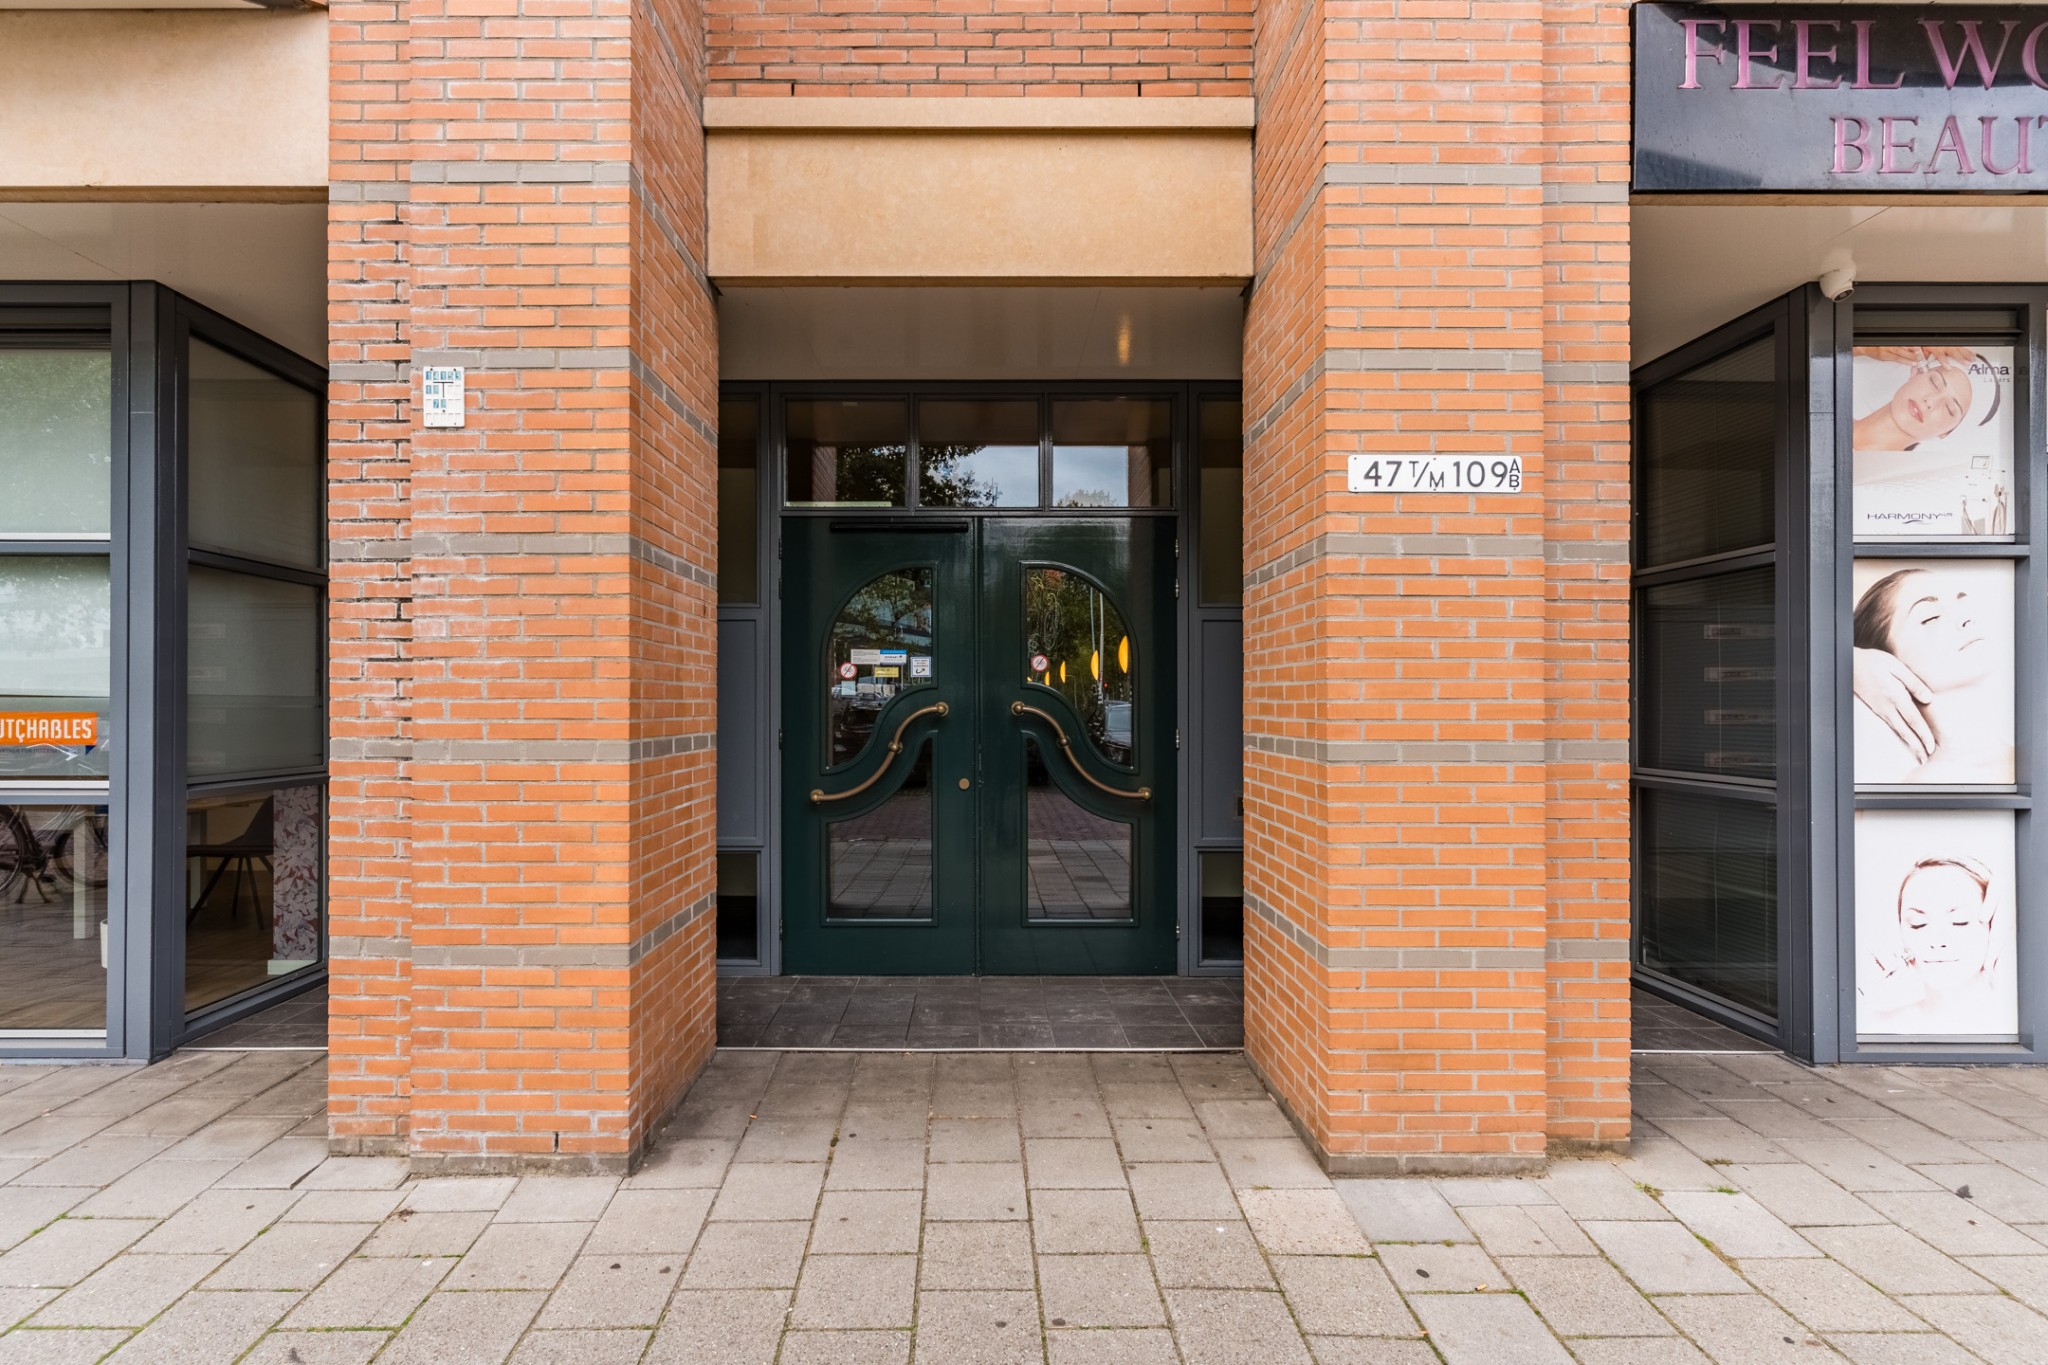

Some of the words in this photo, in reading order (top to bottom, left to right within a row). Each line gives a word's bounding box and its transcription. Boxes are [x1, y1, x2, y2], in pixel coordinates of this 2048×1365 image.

[1677, 19, 1905, 90] FEEL
[1828, 115, 2048, 176] BEAU
[1968, 364, 2010, 375] Alma
[1364, 461, 1402, 488] 47
